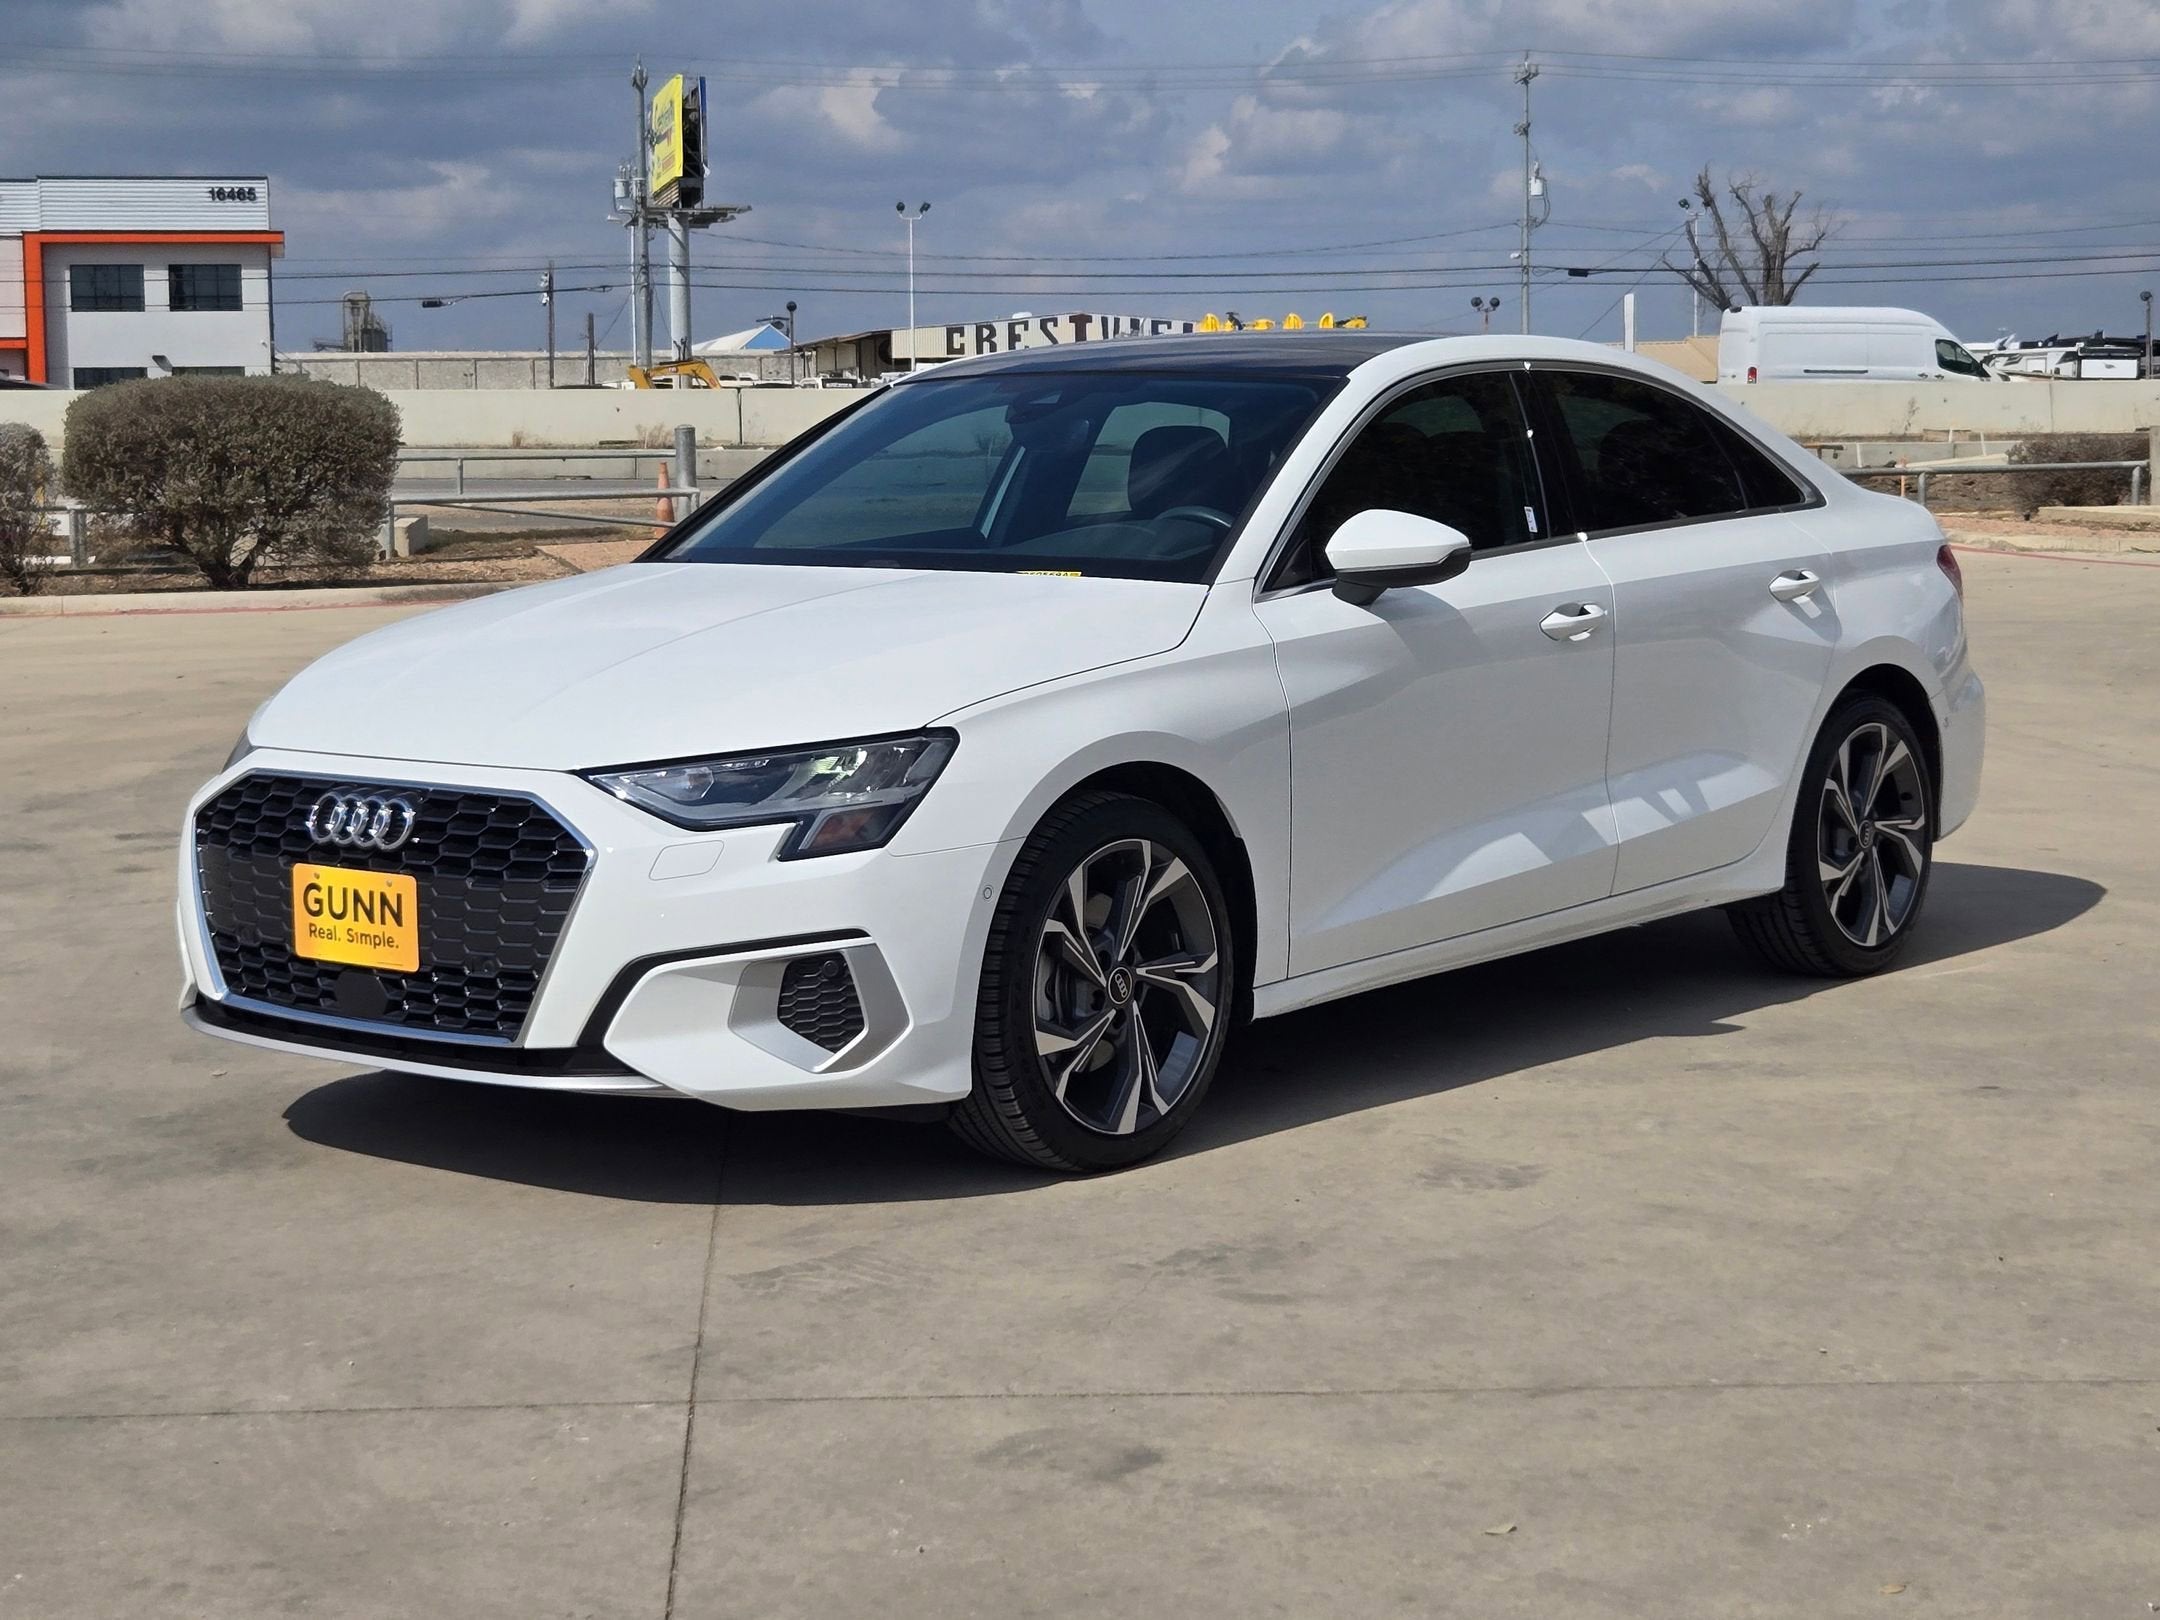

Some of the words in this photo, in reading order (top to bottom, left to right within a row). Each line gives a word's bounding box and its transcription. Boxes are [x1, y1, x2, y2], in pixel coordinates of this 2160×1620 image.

[209, 187, 257, 201] 16465
[945, 314, 1194, 356] CRESTV
[303, 882, 403, 928] GUNN
[309, 922, 342, 943] Real.
[346, 927, 400, 949] Simple.
